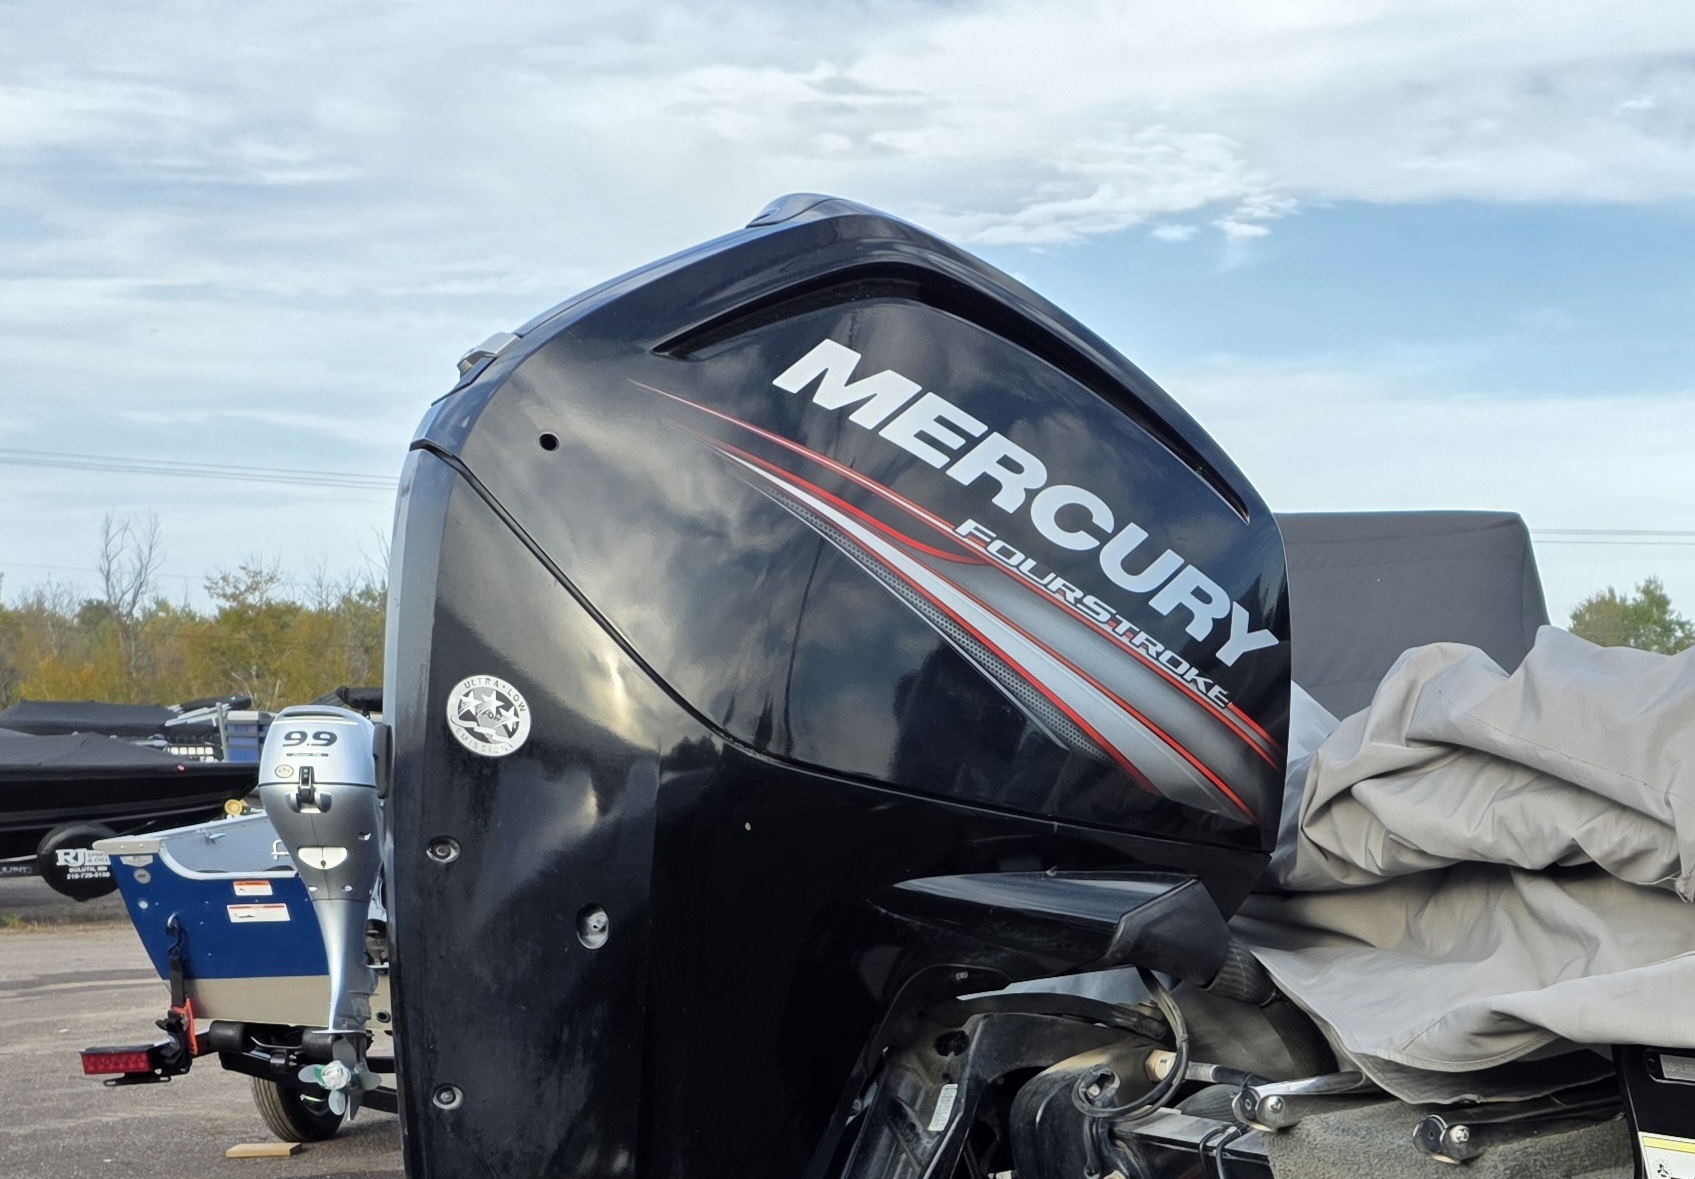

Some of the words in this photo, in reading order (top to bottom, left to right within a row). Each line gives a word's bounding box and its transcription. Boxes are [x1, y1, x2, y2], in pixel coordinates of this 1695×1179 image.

[772, 338, 1280, 668] MERCURY
[954, 517, 1234, 709] FOURSTROKE
[463, 677, 500, 690] ULTRA
[507, 688, 527, 712] LOW
[282, 730, 338, 748] 9.9
[55, 848, 87, 867] RJ
